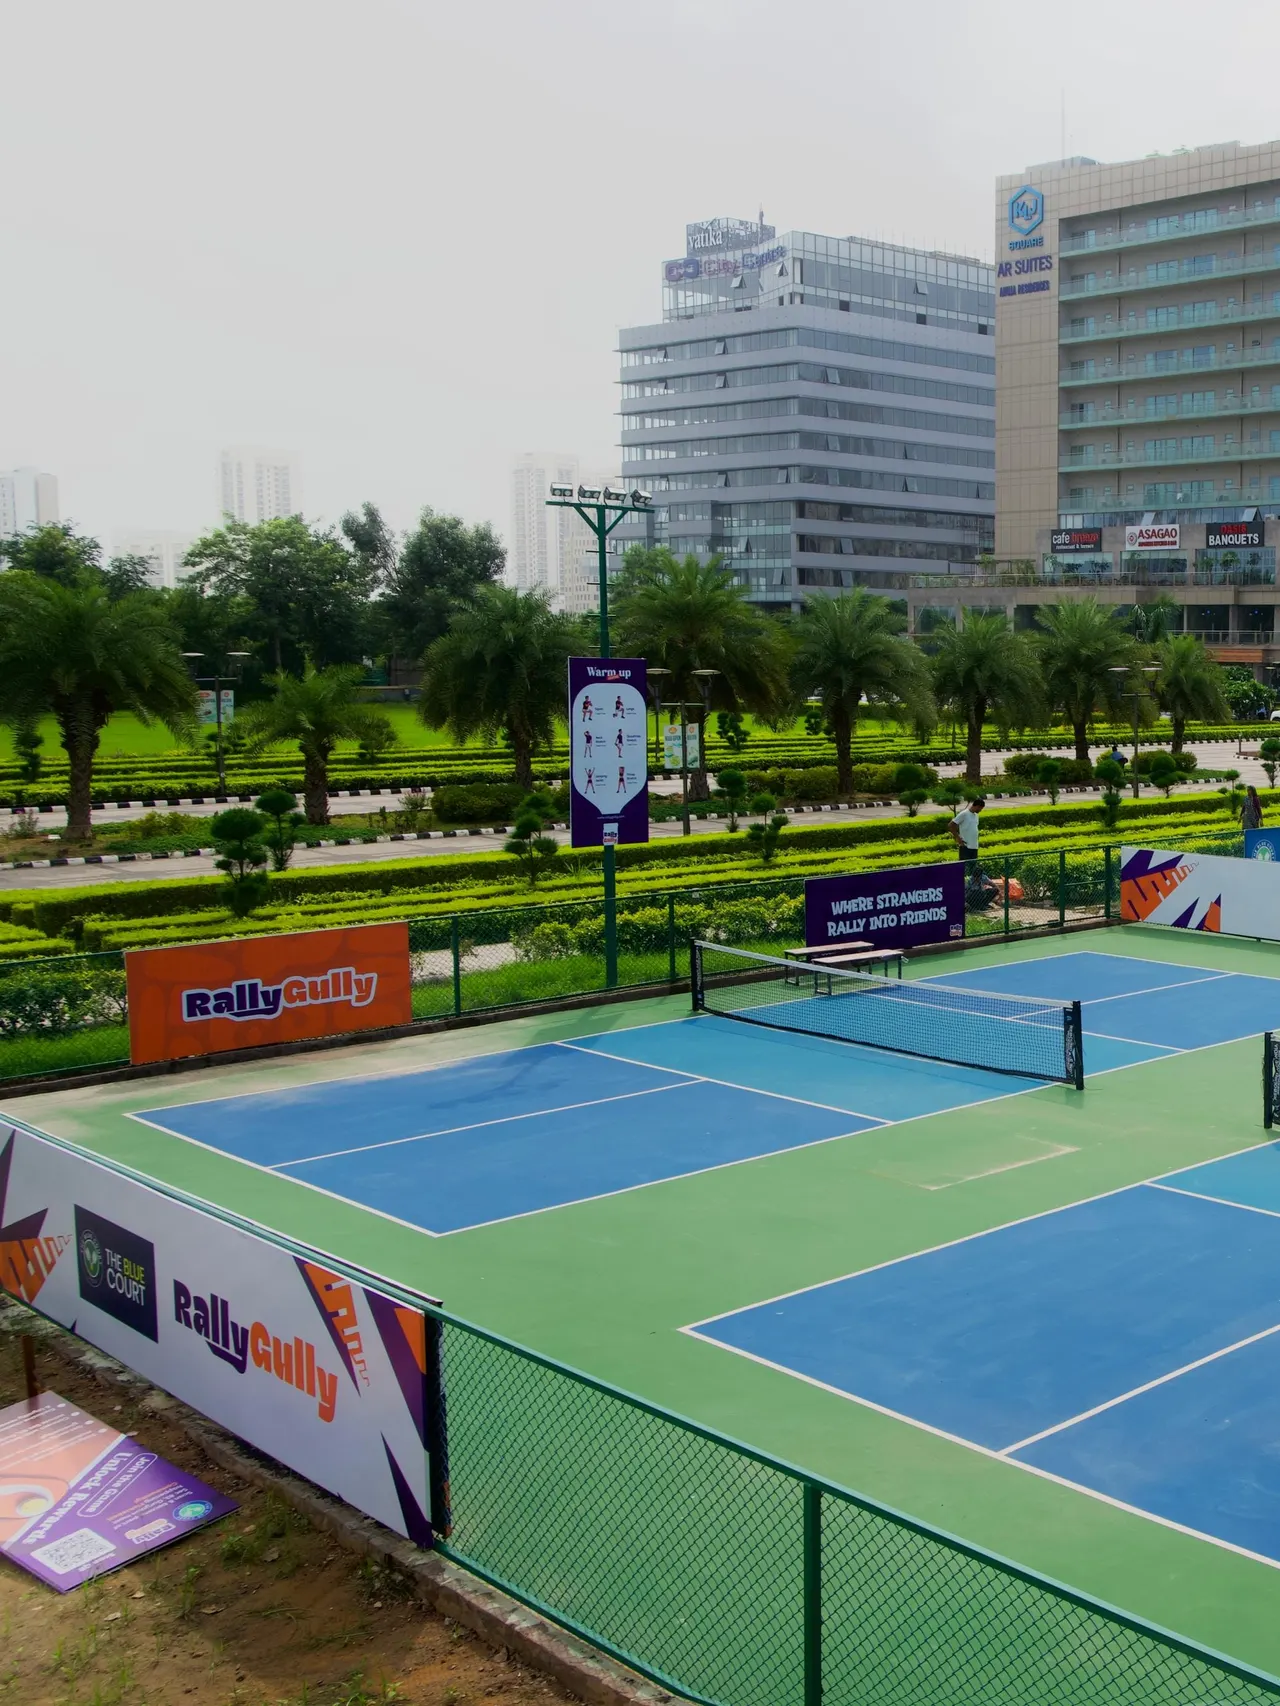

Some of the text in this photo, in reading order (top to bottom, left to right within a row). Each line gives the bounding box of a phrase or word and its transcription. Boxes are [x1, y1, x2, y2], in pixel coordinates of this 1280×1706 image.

[688, 227, 723, 249] vatika
[1008, 237, 1044, 251] SQUARE
[997, 255, 1052, 278] AR SUITES
[1052, 532, 1070, 544] cafe
[1138, 528, 1178, 539] ASAGAO
[1208, 534, 1260, 546] BANQUETS
[586, 667, 617, 676] Warm
[619, 669, 631, 679] up
[831, 887, 943, 916] WHERE STRANGERS
[827, 906, 947, 937] RALLY INTO FRIENDS
[104, 1248, 145, 1285] THE BLUE
[105, 1267, 146, 1306] COURT
[84, 1451, 132, 1492] Unlock
[130, 1456, 151, 1477] Join
[115, 1472, 132, 1493] the
[85, 1482, 118, 1514] Game
[22, 1489, 83, 1546] Rewards
